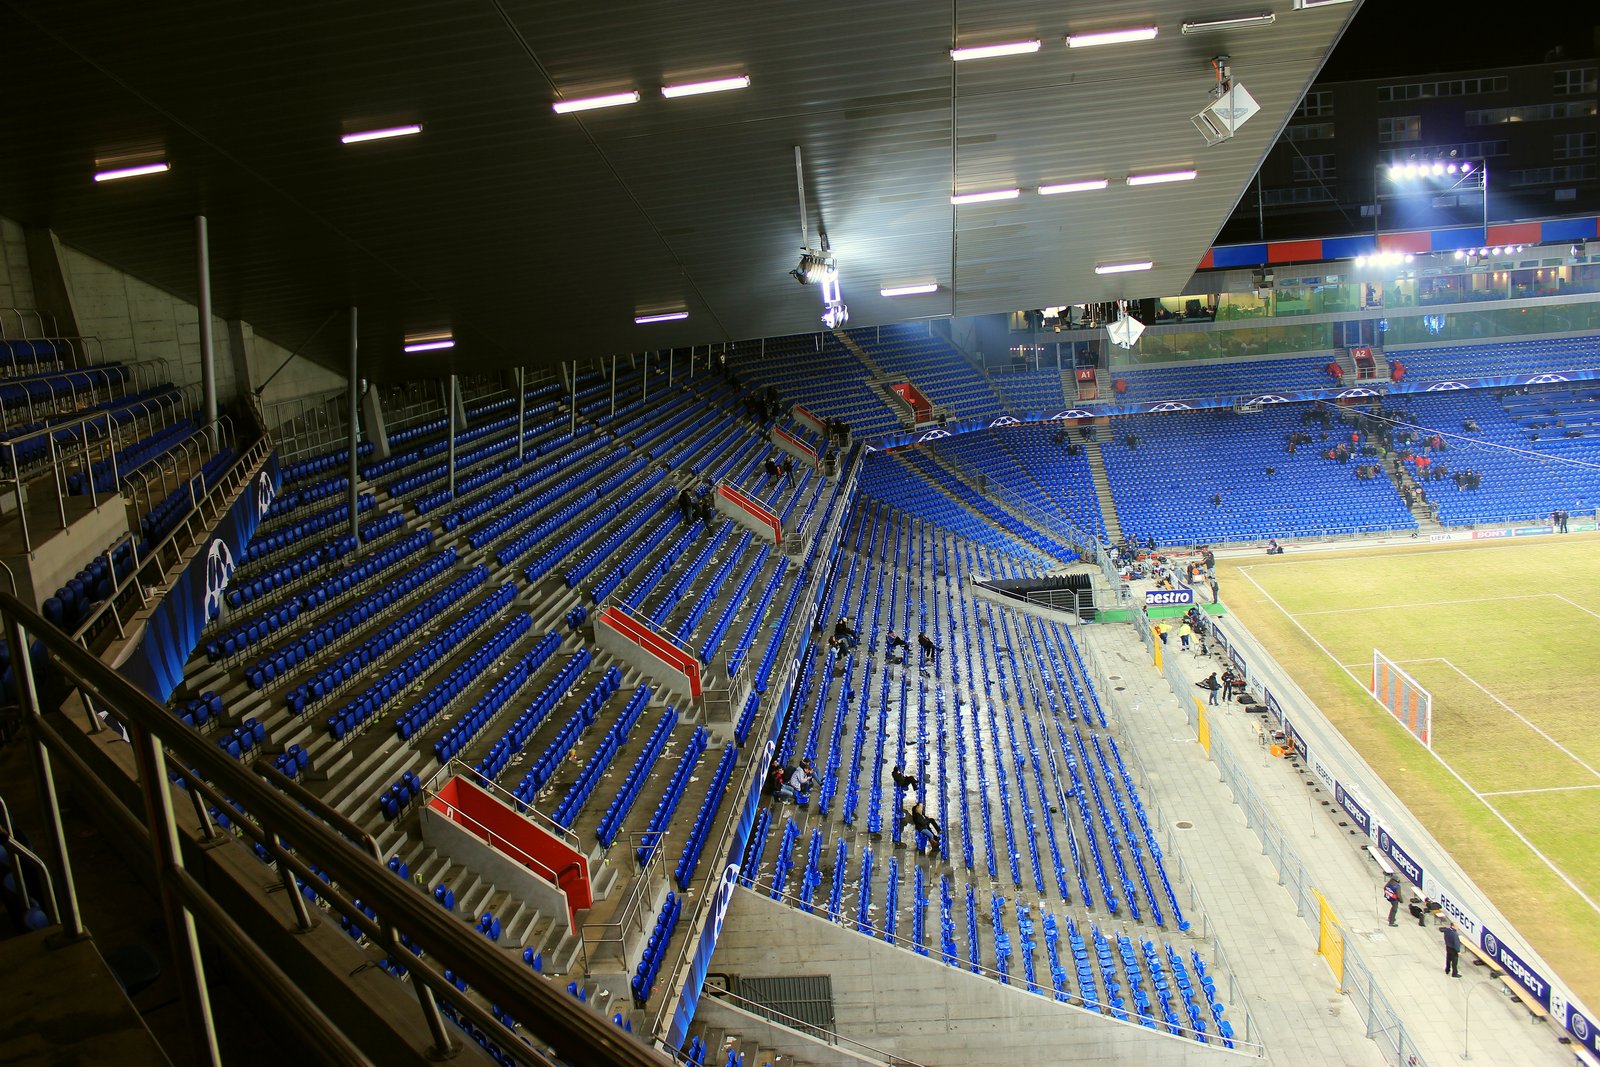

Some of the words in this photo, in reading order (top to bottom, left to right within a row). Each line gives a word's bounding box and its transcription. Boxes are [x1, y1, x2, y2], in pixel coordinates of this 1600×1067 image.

[1477, 530, 1507, 538] SONY
[1146, 592, 1190, 604] aestro
[1344, 796, 1366, 826] RESPECT
[1391, 845, 1419, 880] RESPECT
[1440, 893, 1475, 934] RESPECT
[1501, 948, 1543, 997] RESPECT
